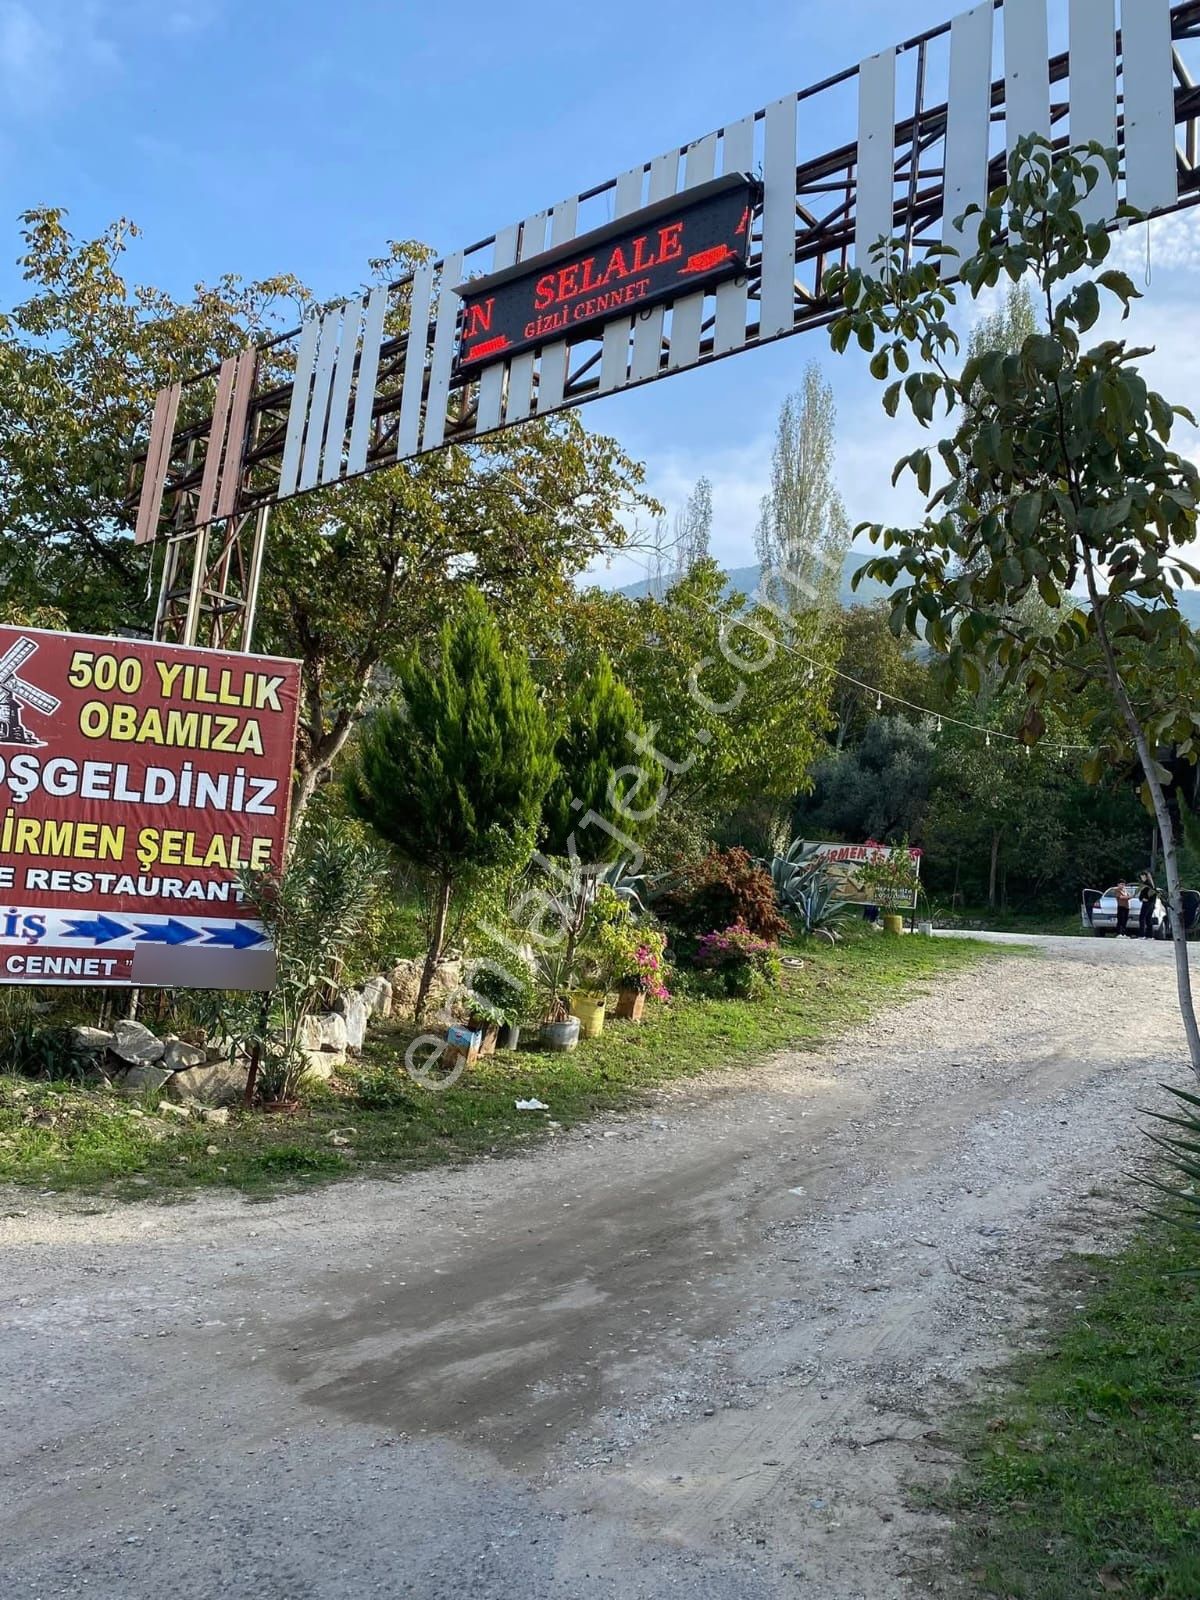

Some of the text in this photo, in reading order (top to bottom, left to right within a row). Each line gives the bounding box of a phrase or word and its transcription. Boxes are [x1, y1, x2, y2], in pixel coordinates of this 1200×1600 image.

[534, 222, 684, 310] SELALE
[524, 278, 650, 338] GİZLİ CENNET
[68, 651, 285, 711] 500 YILLIK
[79, 701, 264, 755] OBAMIZA
[0, 753, 278, 815] ŞGELDİNİZ
[137, 828, 272, 872] ŞELALE
[26, 868, 246, 902] RESTAURANT
[0, 906, 47, 944] İŞ
[6, 955, 117, 976] CENNET
